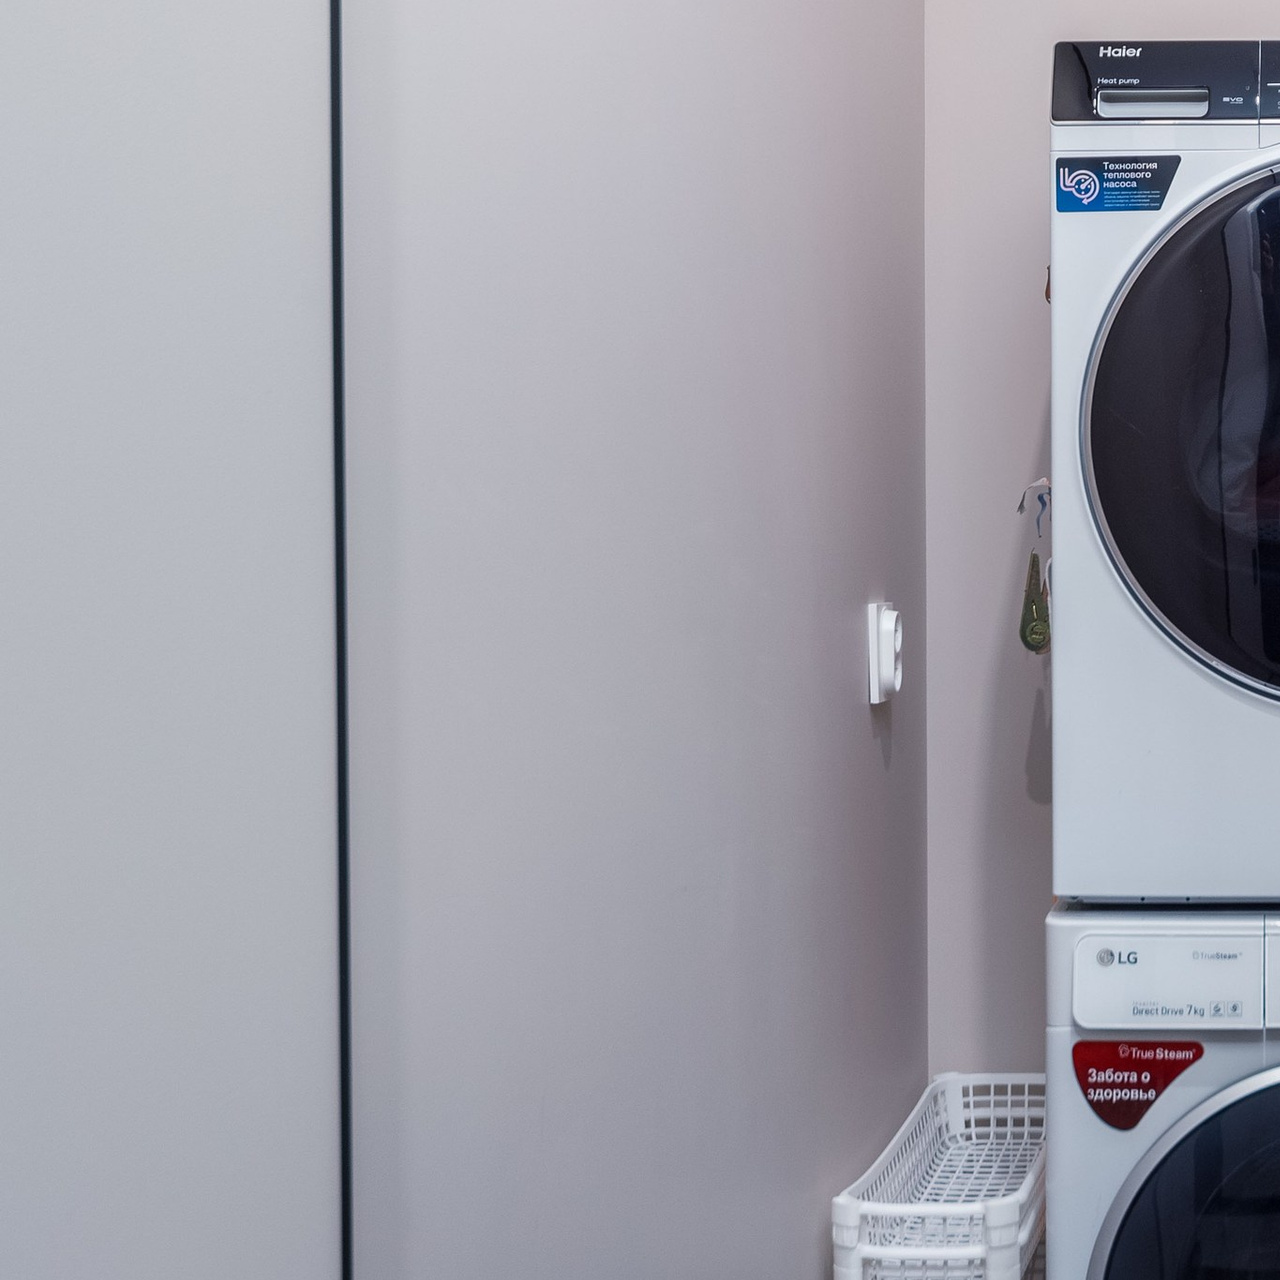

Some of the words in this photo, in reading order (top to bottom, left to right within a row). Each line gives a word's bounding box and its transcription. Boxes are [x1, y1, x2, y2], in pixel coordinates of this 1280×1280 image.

[1099, 46, 1143, 58] Haier
[1118, 78, 1140, 86] pump
[1102, 161, 1158, 172] Технология
[1102, 171, 1152, 180] теплового
[1103, 180, 1138, 188] насоса
[1118, 951, 1138, 965] LG
[1132, 1006, 1160, 1016] Direct
[1161, 1006, 1184, 1016] Drive
[1087, 1068, 1137, 1083] Забота
[1140, 1072, 1151, 1083] о
[1087, 1088, 1157, 1104] здоровье
